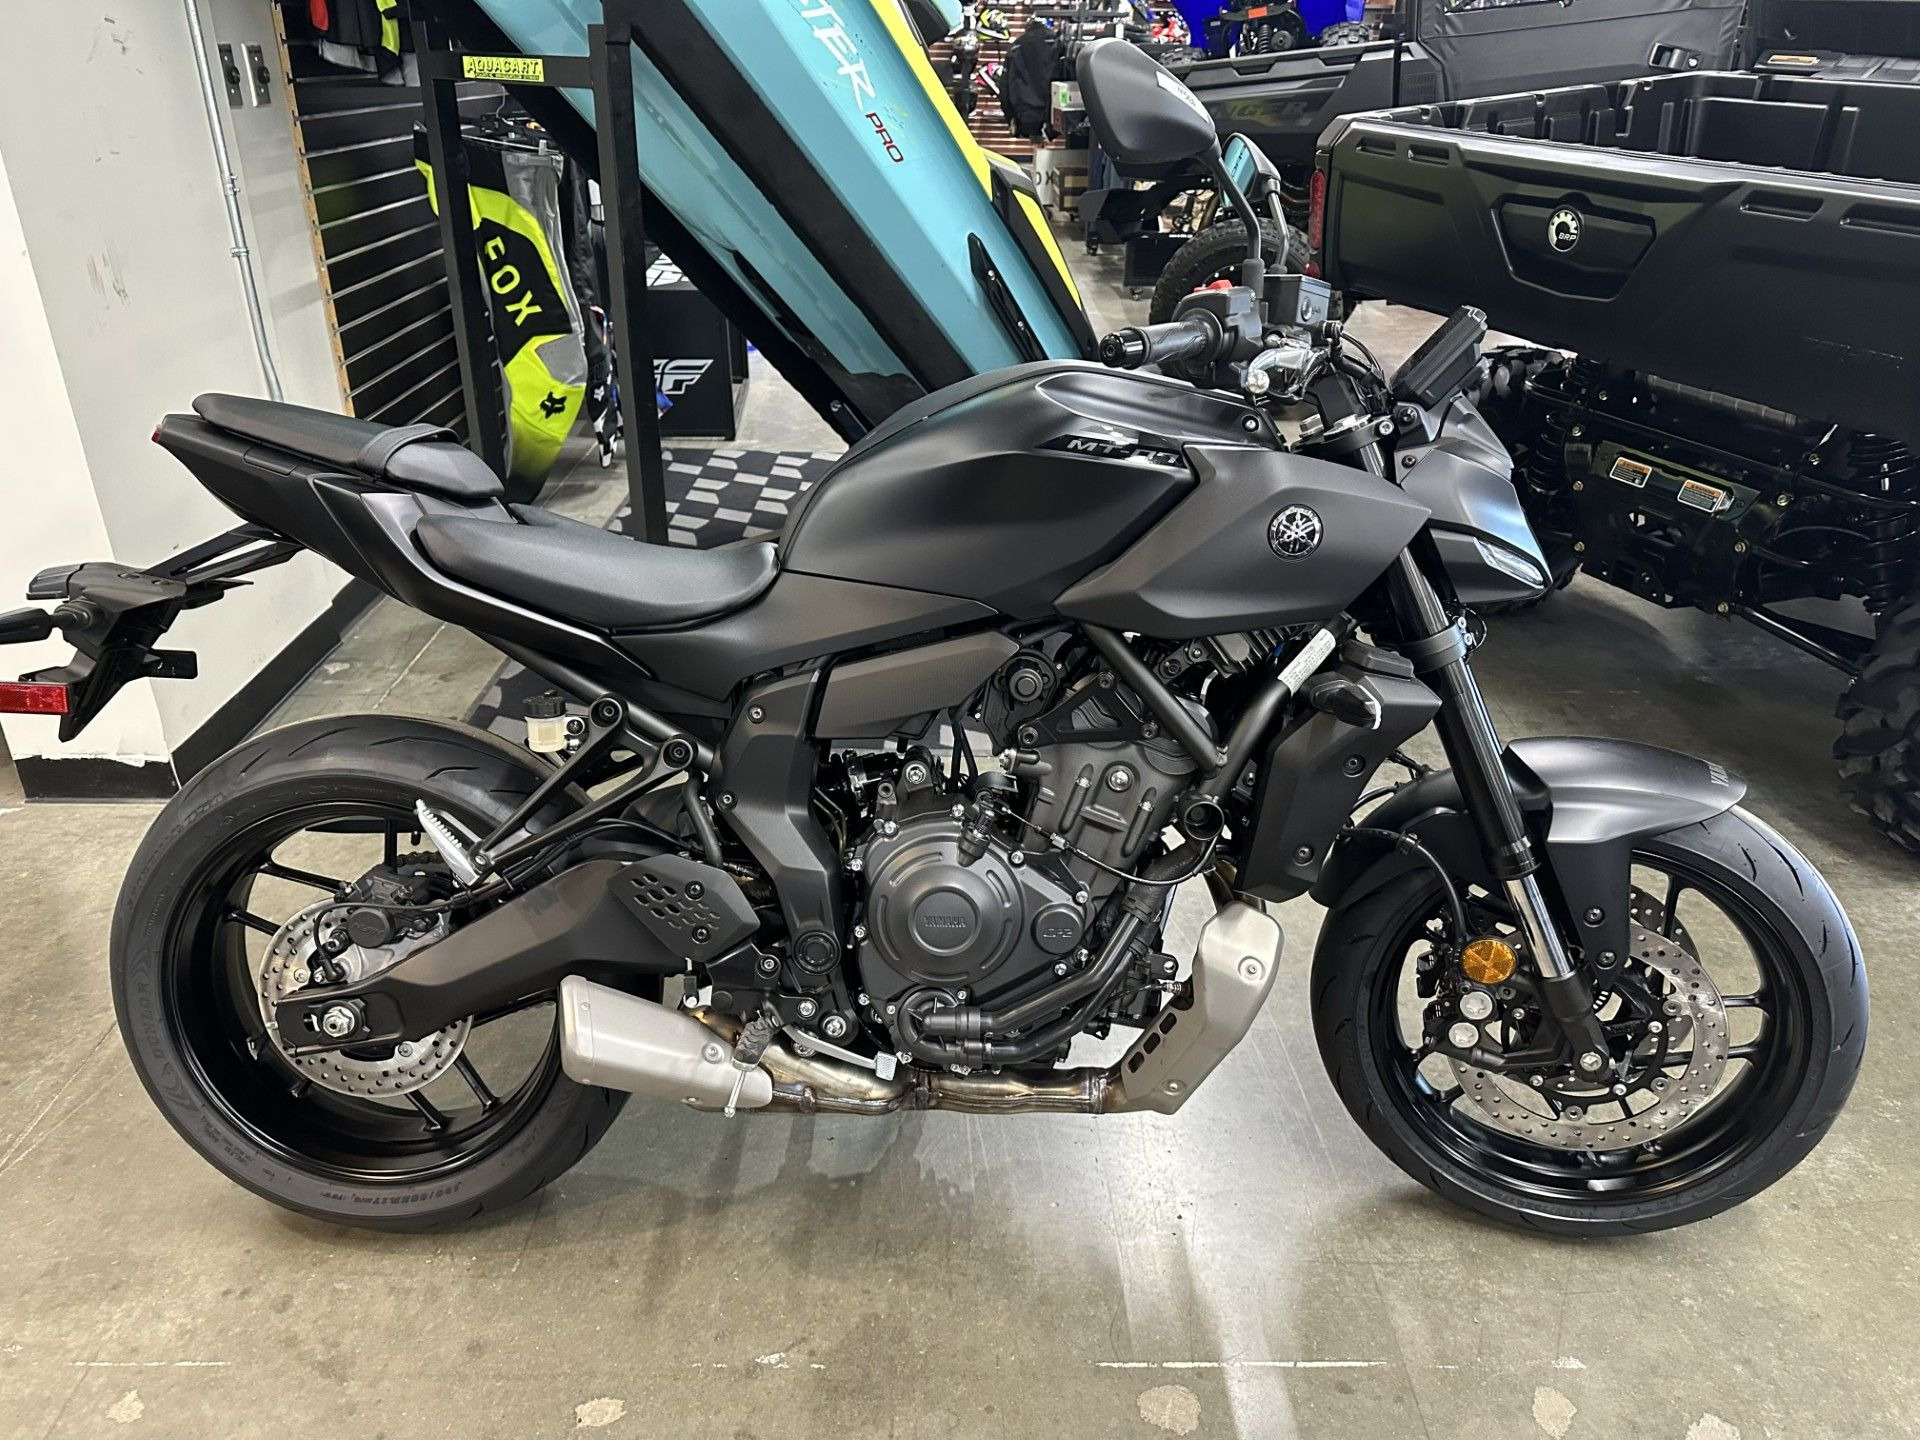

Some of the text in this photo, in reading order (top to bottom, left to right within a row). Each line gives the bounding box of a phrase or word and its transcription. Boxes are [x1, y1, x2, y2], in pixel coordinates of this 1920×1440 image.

[466, 57, 539, 75] AQUACART
[800, 0, 904, 163] TER PRO
[1211, 100, 1309, 122] NGER
[1558, 231, 1577, 242] BRP
[485, 236, 543, 327] FOX
